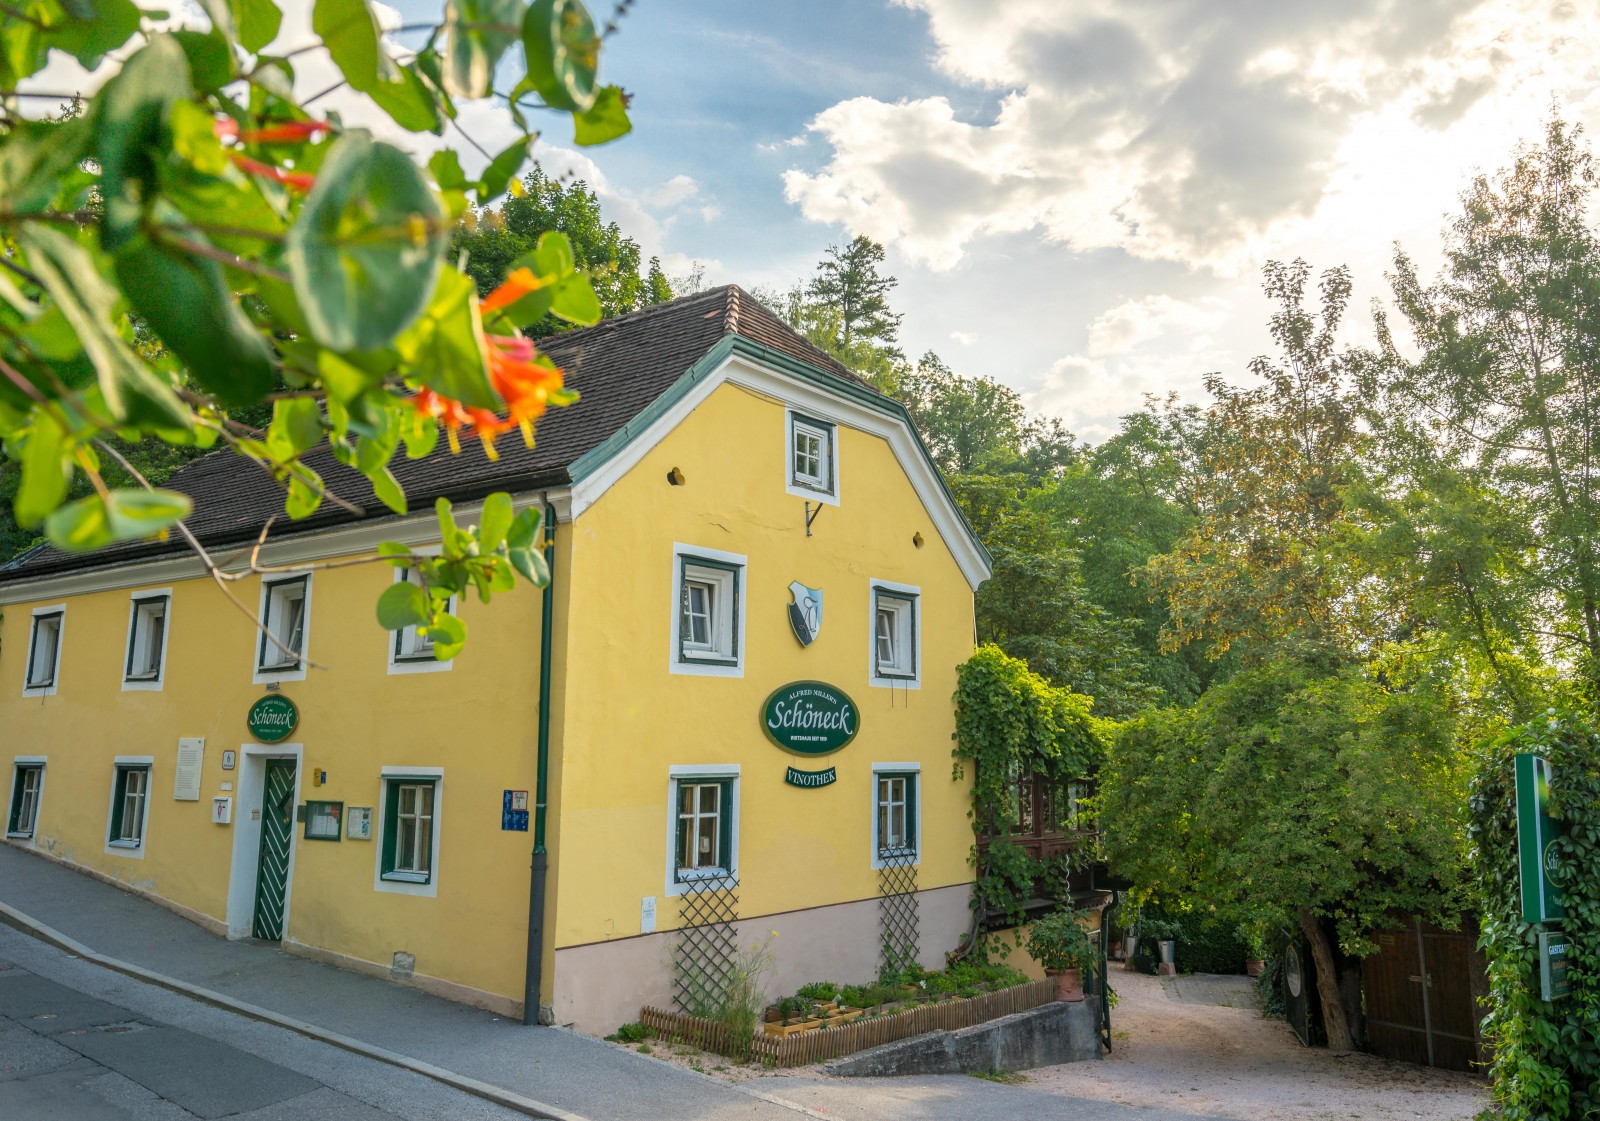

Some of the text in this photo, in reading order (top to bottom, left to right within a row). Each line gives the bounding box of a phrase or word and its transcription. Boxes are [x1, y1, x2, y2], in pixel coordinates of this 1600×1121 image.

[789, 689, 812, 700] ALFRED
[250, 706, 293, 729] Schöneck
[768, 699, 853, 735] Schöneck
[788, 769, 836, 786] VINOTHEK
